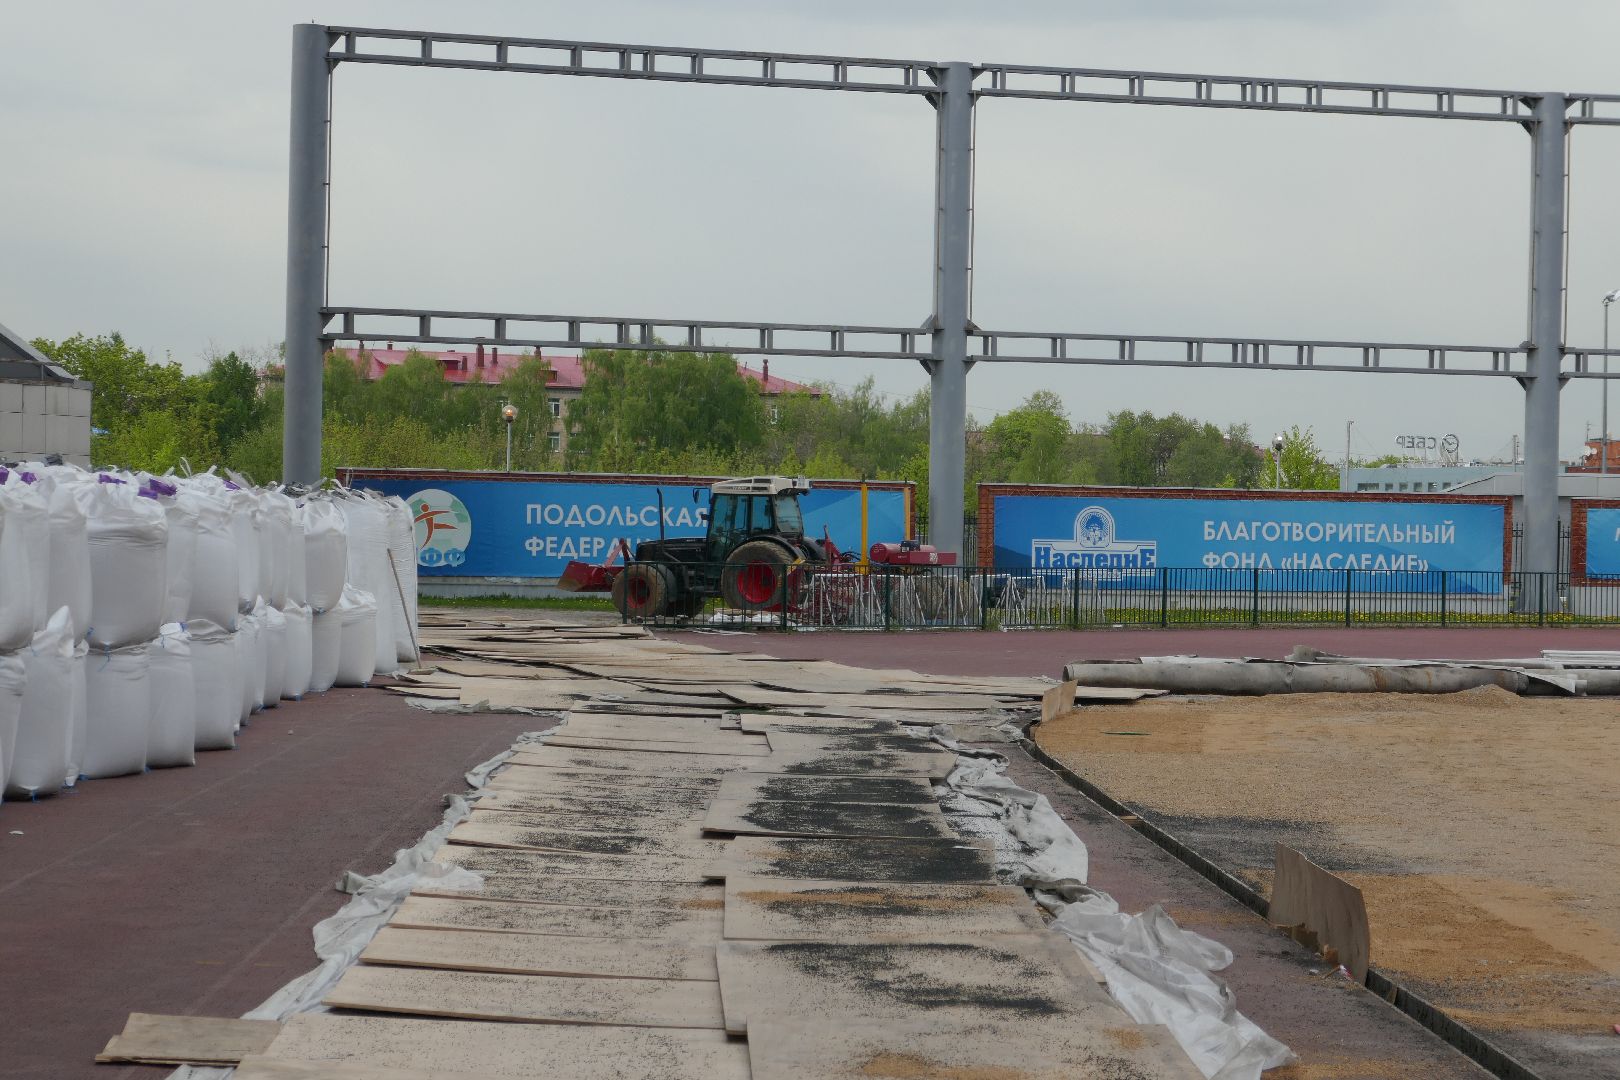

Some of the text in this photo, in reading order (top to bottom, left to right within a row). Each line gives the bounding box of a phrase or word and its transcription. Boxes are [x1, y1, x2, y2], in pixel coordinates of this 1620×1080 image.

[525, 503, 708, 528] ПОДОЛЬСКАЯ
[1203, 520, 1456, 544] БЛАГОТВОРИТЕЛЬНЫЙ
[1202, 551, 1429, 576] ФОНД «НАСЛЕДИЕ»
